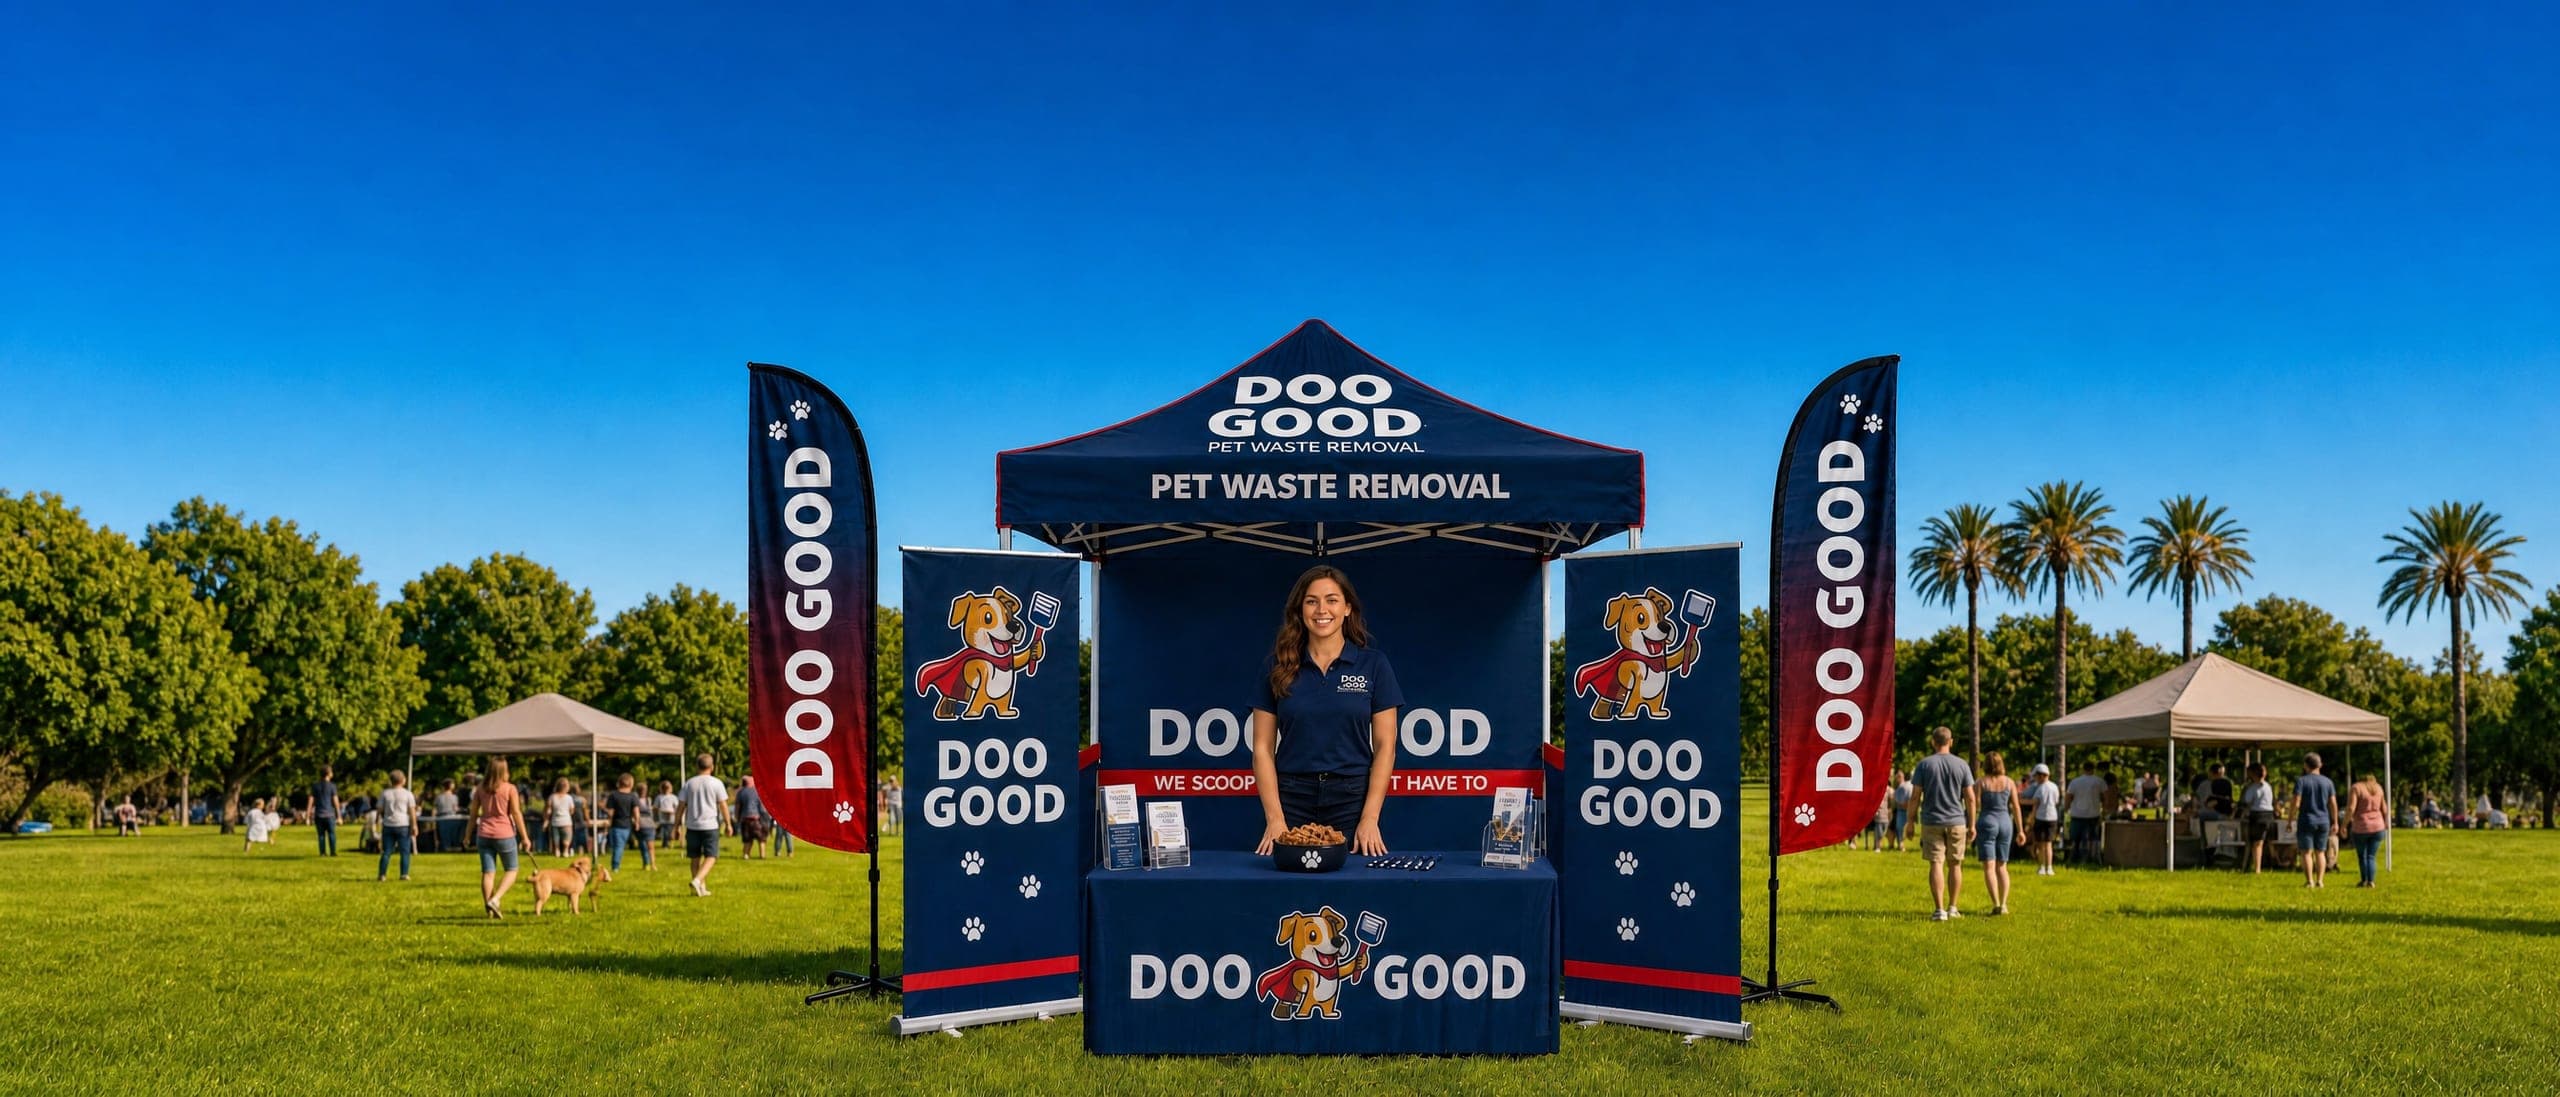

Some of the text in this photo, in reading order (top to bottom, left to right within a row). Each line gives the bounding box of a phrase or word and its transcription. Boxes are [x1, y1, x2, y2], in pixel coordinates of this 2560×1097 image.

[1234, 373, 1393, 405] DOO
[1208, 406, 1422, 438] GOOD
[1208, 441, 1425, 453] PET WASTE REMOVAL
[1151, 473, 1510, 499] PET WASTE REMOVAL
[783, 447, 834, 790] DOO GOOD
[1815, 440, 1865, 792] DOO GOOD
[938, 737, 1048, 780] DOO
[1593, 739, 1703, 782] DOO
[1154, 775, 1185, 791] WE
[1192, 775, 1256, 791] SCOOP
[1407, 775, 1458, 791] HAVE
[1462, 775, 1488, 791] TO
[923, 784, 1065, 828] GOOD
[1580, 785, 1722, 829] GOOD
[1130, 953, 1526, 1000] DOO GOOD
